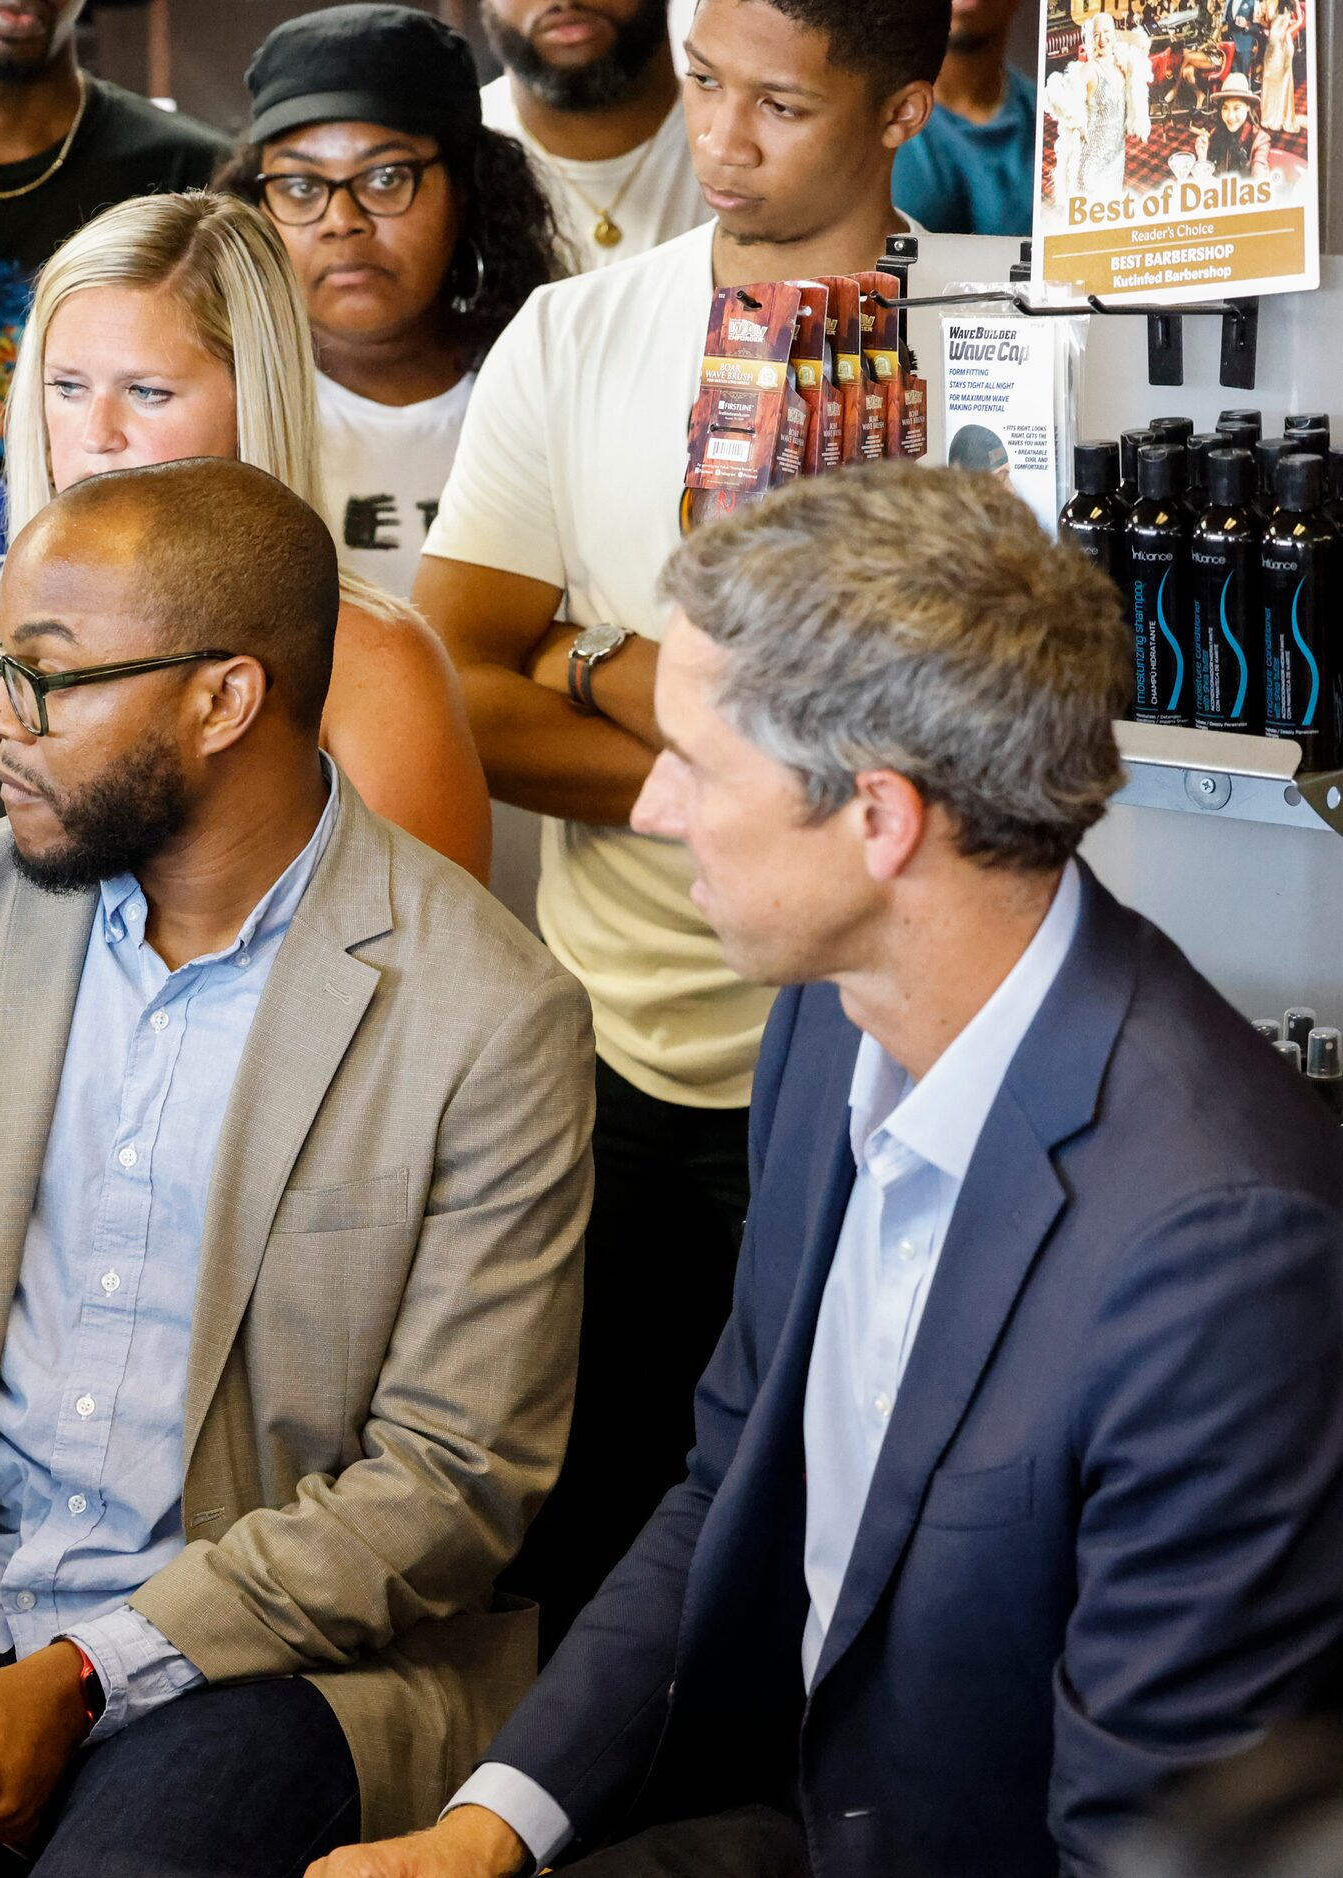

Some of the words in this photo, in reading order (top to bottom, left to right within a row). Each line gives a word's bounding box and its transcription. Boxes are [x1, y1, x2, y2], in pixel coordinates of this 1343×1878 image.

[1068, 192, 1135, 226] Best
[1142, 184, 1174, 217] of
[1180, 176, 1271, 213] Dallas
[1131, 226, 1175, 243] Reader's
[1176, 223, 1215, 237] Choice
[1110, 255, 1142, 271] BEST
[1144, 243, 1235, 267] BARBERSHOP
[1164, 264, 1232, 283] Barbershop
[948, 340, 996, 361] Wave
[997, 341, 1029, 365] Cap
[705, 370, 726, 379] WAVE
[727, 371, 754, 381] BRUSH
[720, 362, 741, 372] BOAR
[949, 368, 965, 376] FORM
[949, 381, 966, 389] STAYS
[967, 381, 984, 389] TIGHT
[949, 393, 960, 401] FOR
[960, 394, 991, 402] MAXIMUM
[949, 403, 972, 411] MAKING
[972, 404, 1005, 412] POTENTIAL
[1134, 580, 1146, 633] shampoo
[1149, 620, 1157, 670] HIDRATANTE
[1135, 635, 1147, 704] moisturizing
[1150, 671, 1158, 705] CHAMPÚ
[1195, 661, 1203, 710] moisture
